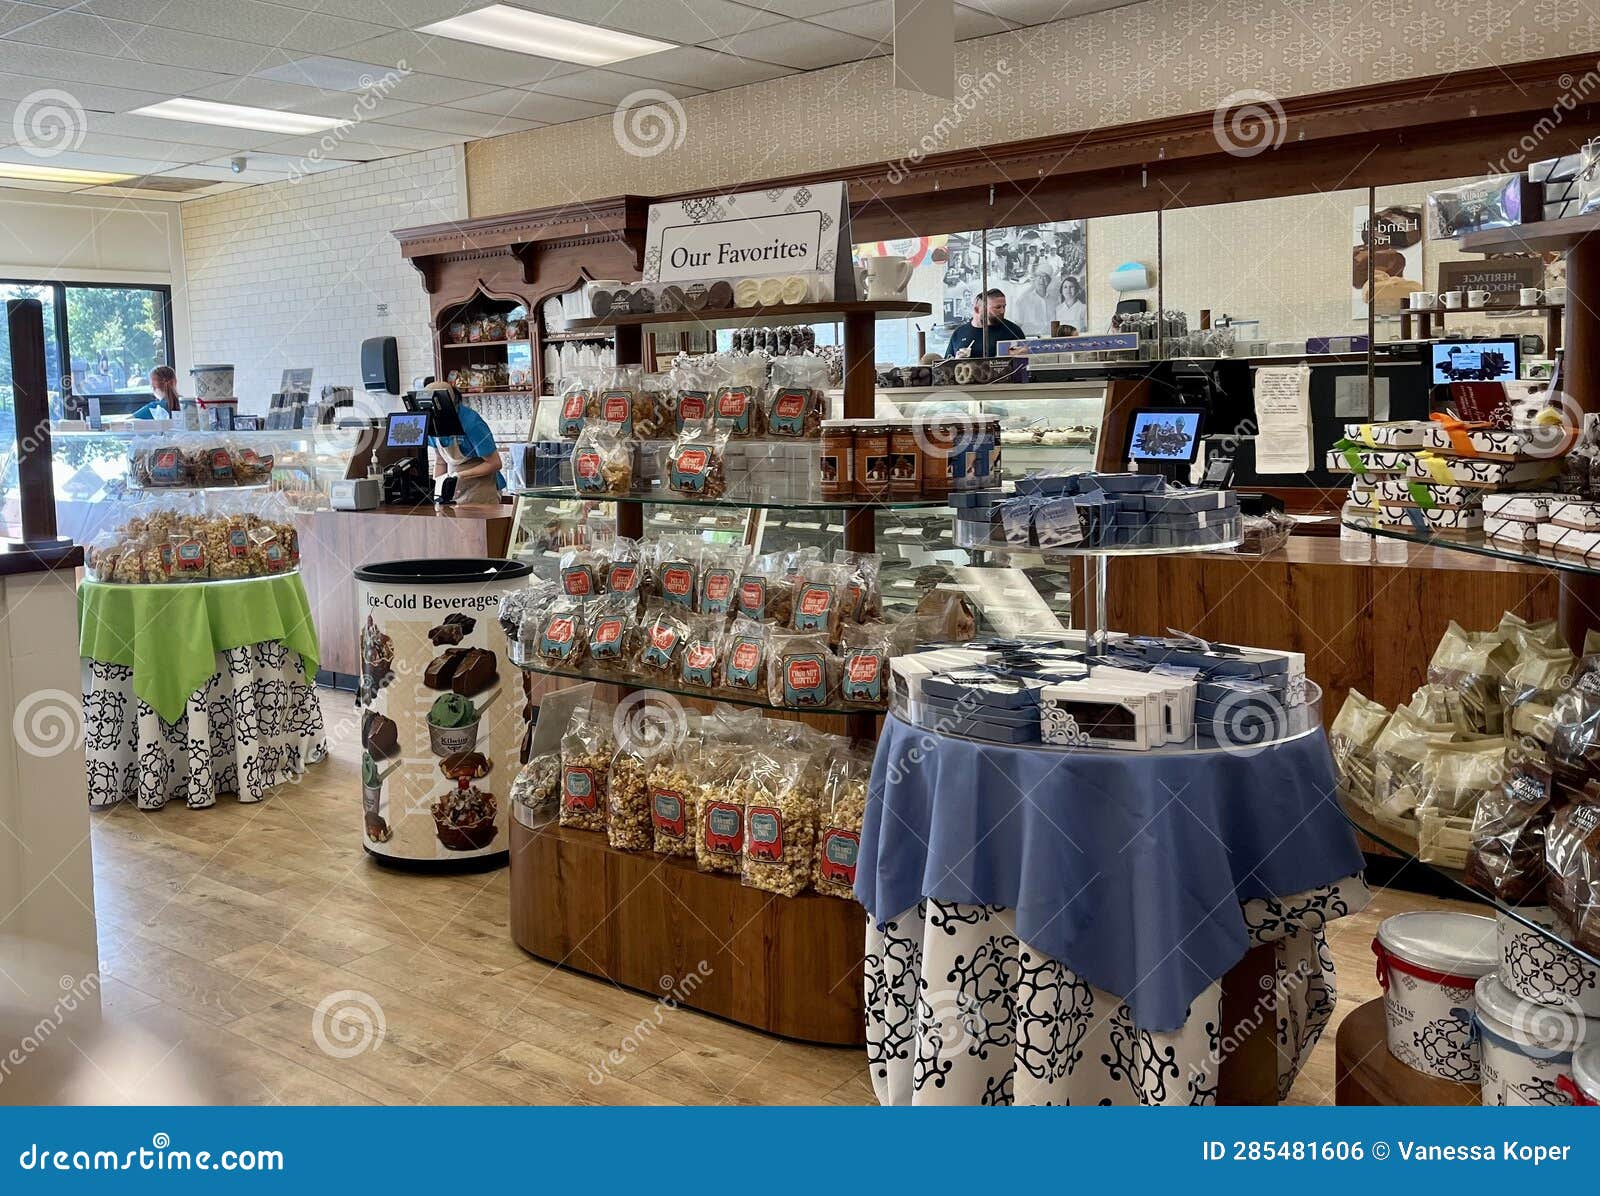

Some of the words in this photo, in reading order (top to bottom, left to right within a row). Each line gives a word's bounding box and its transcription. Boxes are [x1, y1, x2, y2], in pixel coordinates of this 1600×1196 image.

[670, 246, 711, 269] Our
[717, 238, 808, 265] Favorites
[366, 592, 417, 609] Ice-Cold
[423, 594, 499, 611] Beverages
